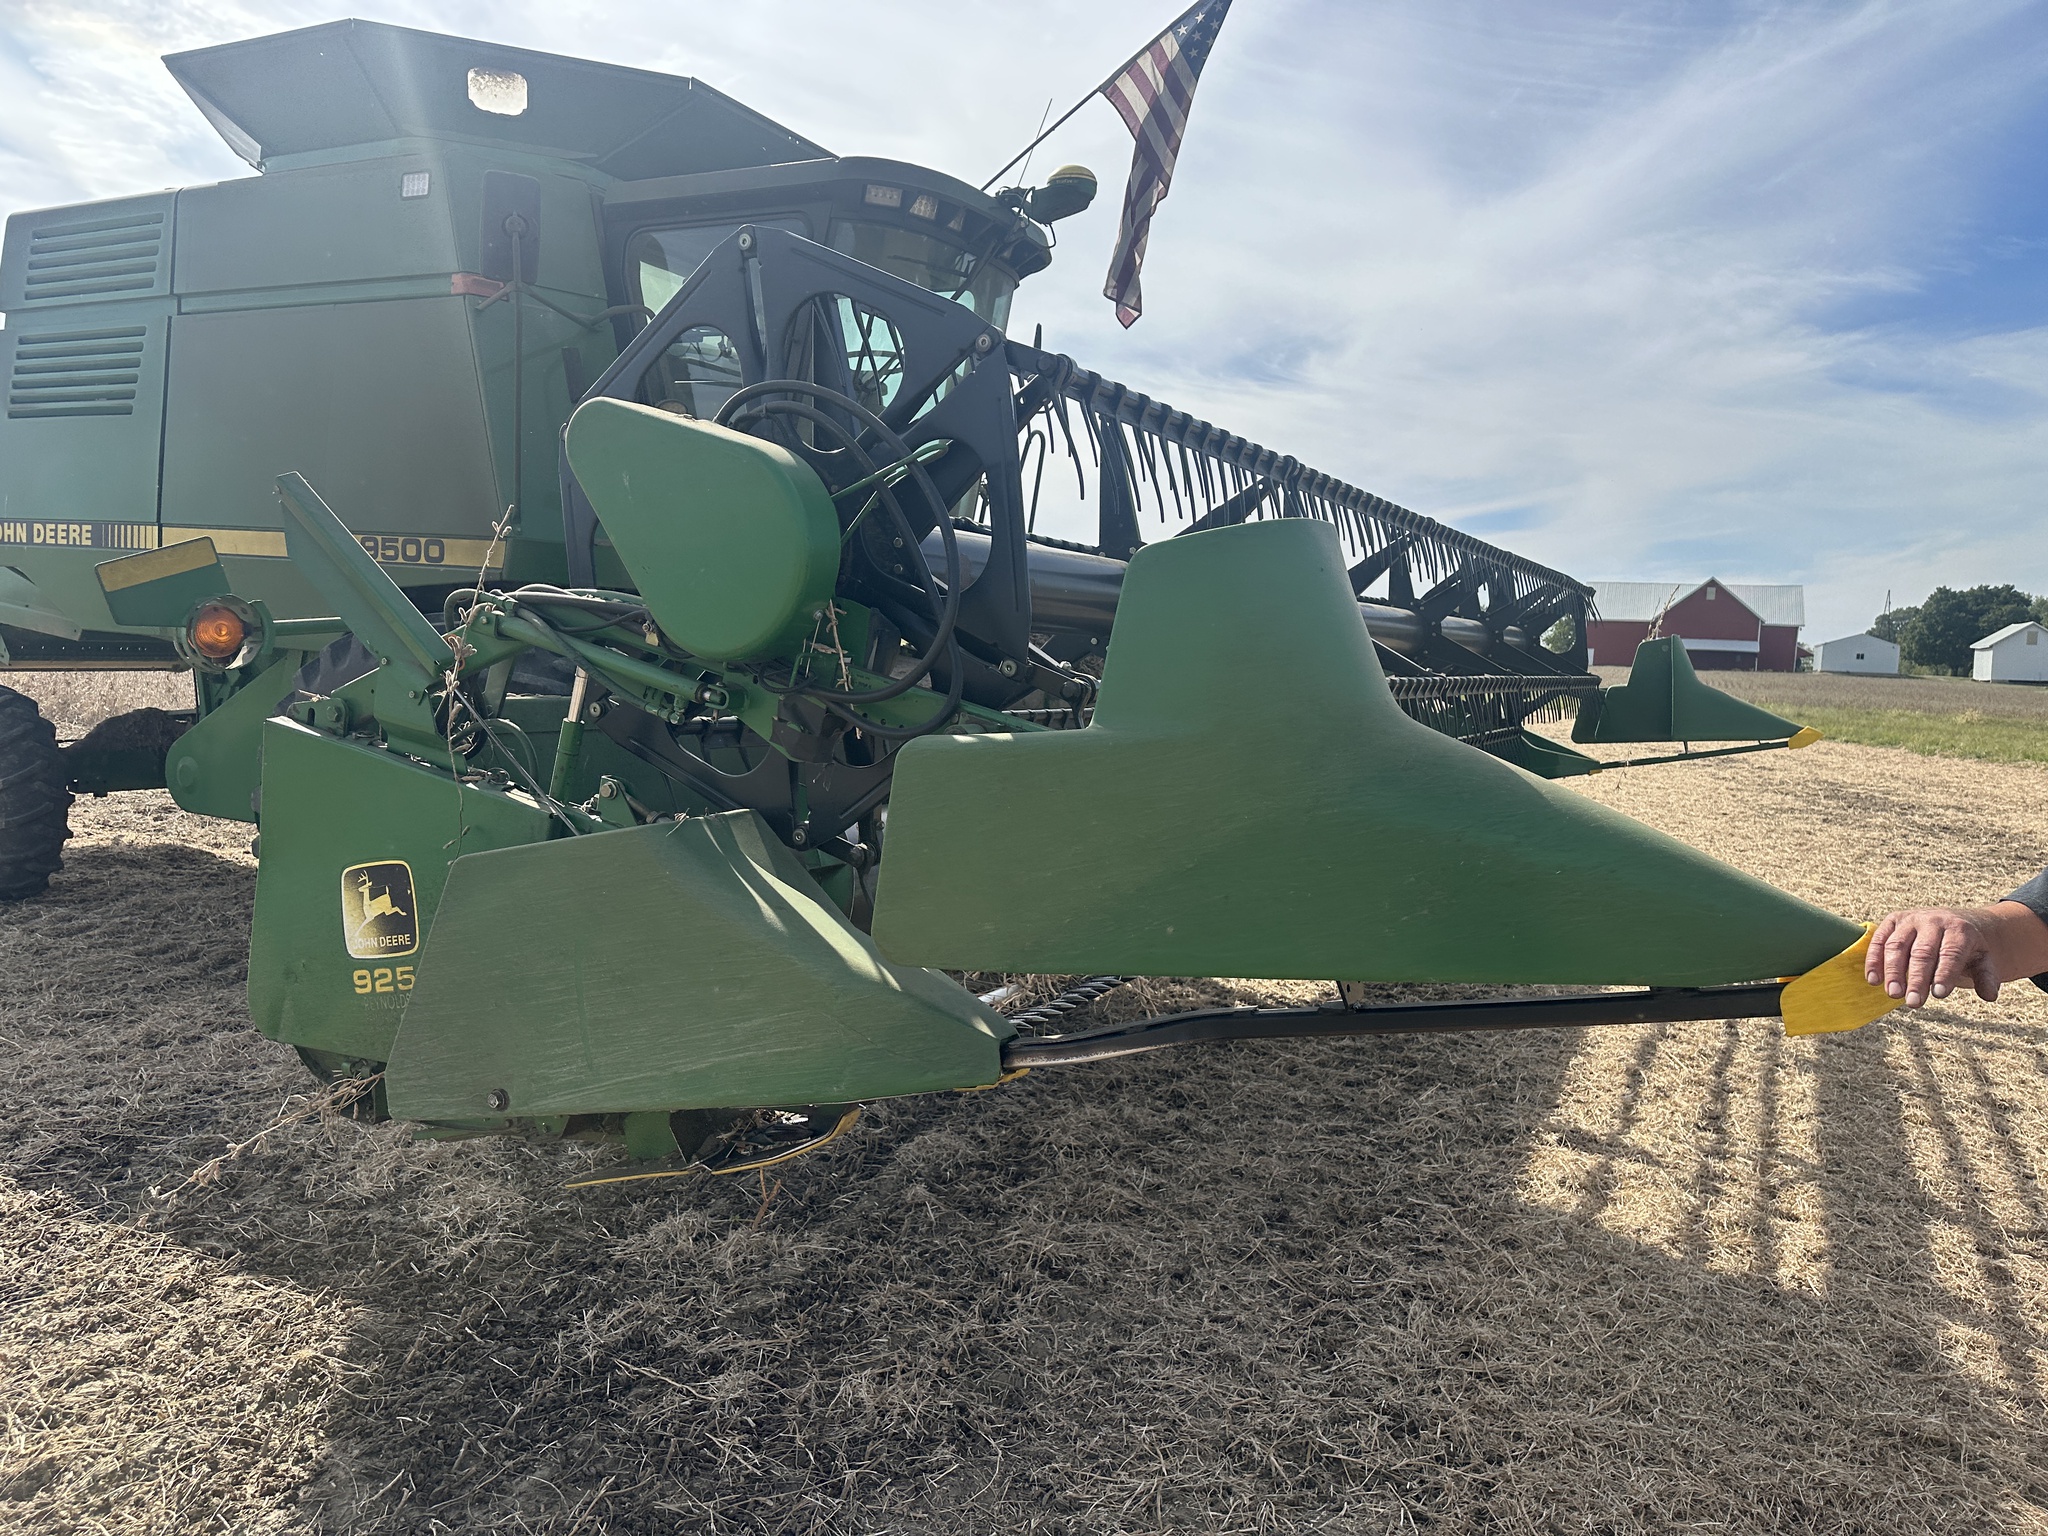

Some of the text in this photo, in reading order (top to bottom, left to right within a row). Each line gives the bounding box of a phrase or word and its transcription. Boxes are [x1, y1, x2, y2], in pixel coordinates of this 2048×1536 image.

[33, 523, 92, 546] DEERE
[360, 536, 445, 564] 9500
[352, 934, 411, 950] JOHN DEERE
[353, 966, 415, 994] 925
